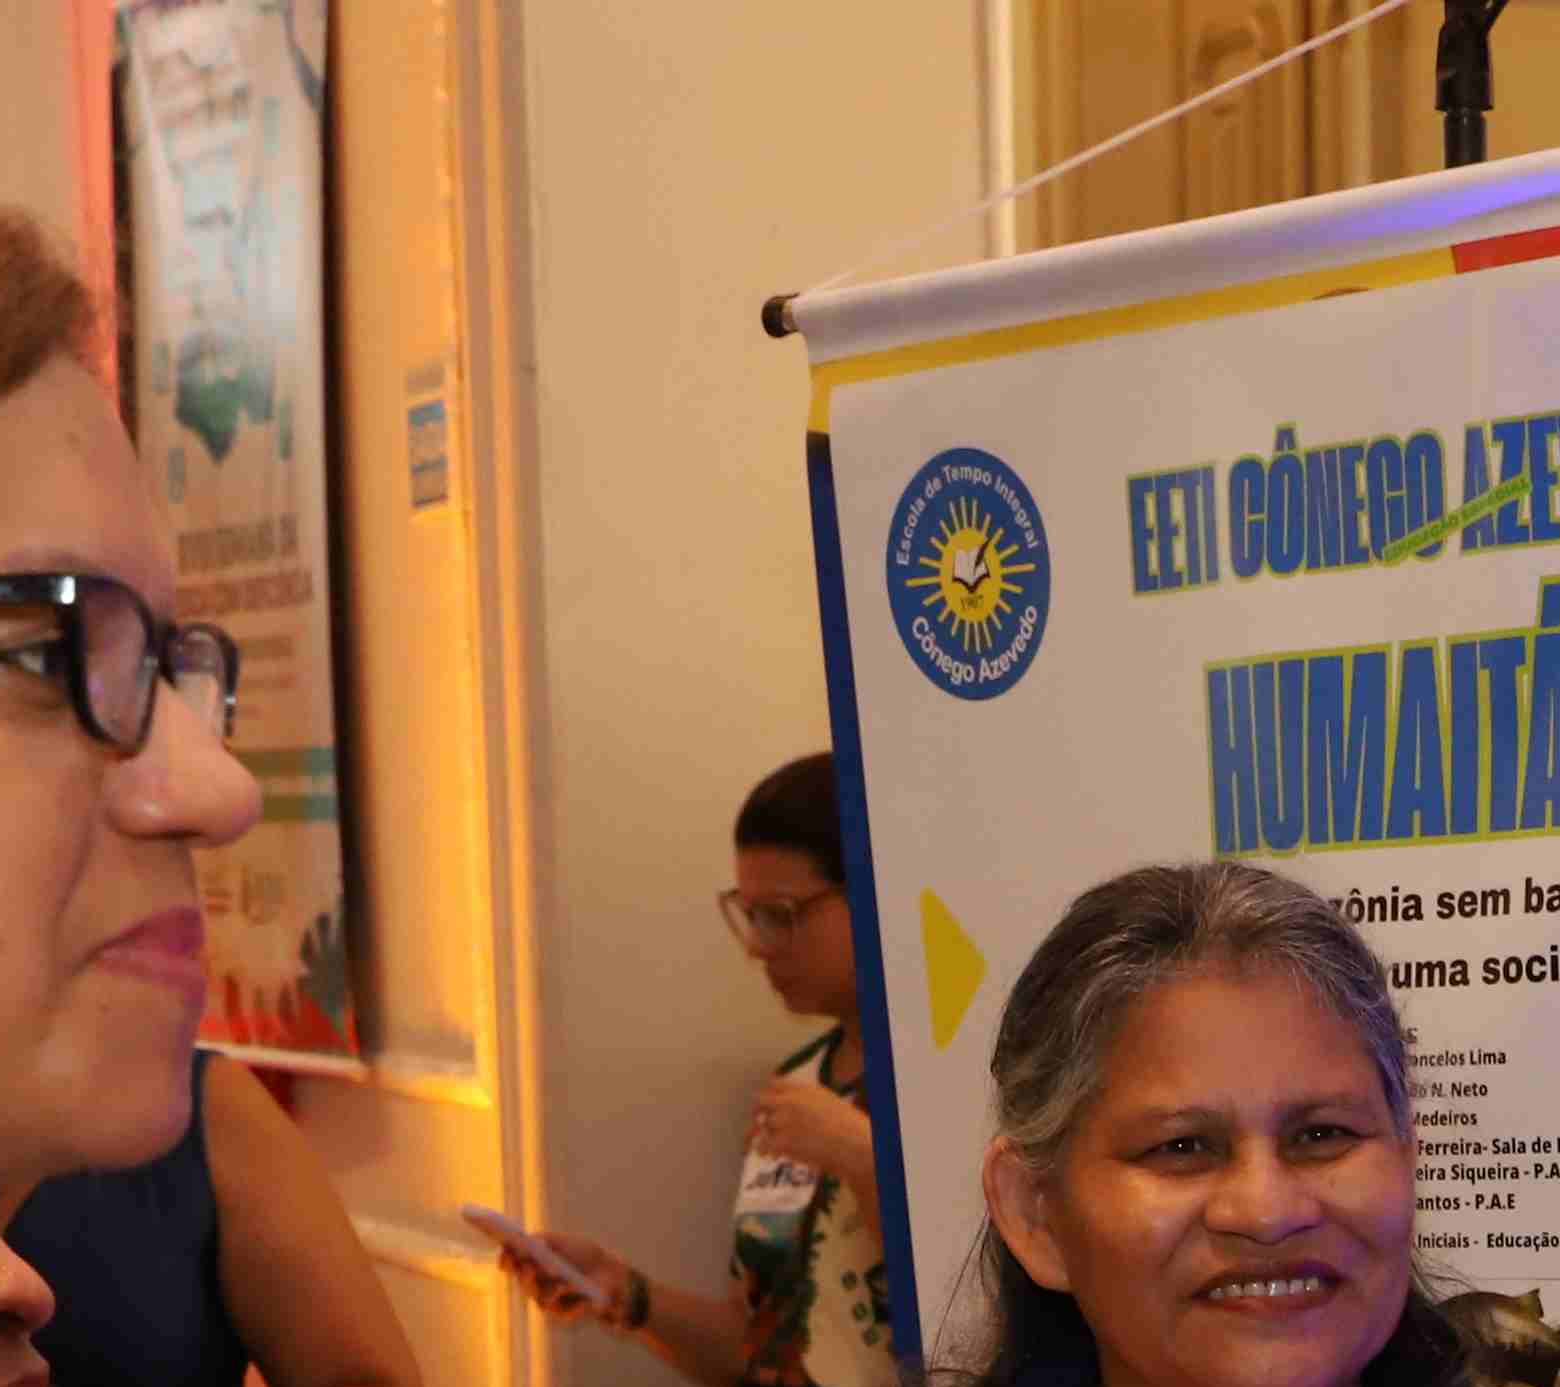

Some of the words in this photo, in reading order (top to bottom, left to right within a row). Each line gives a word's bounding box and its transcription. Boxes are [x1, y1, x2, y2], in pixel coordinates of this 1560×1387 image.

[896, 497, 926, 566] Escola
[924, 477, 942, 499] de
[943, 464, 991, 486] Tempo
[994, 476, 1039, 550] Integral
[1126, 461, 1220, 597] EETI
[1228, 421, 1447, 579] CÔNEGO
[912, 616, 974, 685] Cônego
[978, 605, 1038, 683] Azevedo
[1435, 884, 1511, 918] sem
[1390, 951, 1469, 990] uma
[1470, 1050, 1506, 1066] Lima
[1450, 1081, 1488, 1097] Neto
[1491, 1138, 1527, 1155] Sala
[1531, 1137, 1552, 1154] de
[1451, 1163, 1520, 1185] Siqueira
[1474, 1193, 1516, 1211] P.A.E
[1417, 1233, 1470, 1249] Iniciais
[1486, 1232, 1560, 1251] Educação
